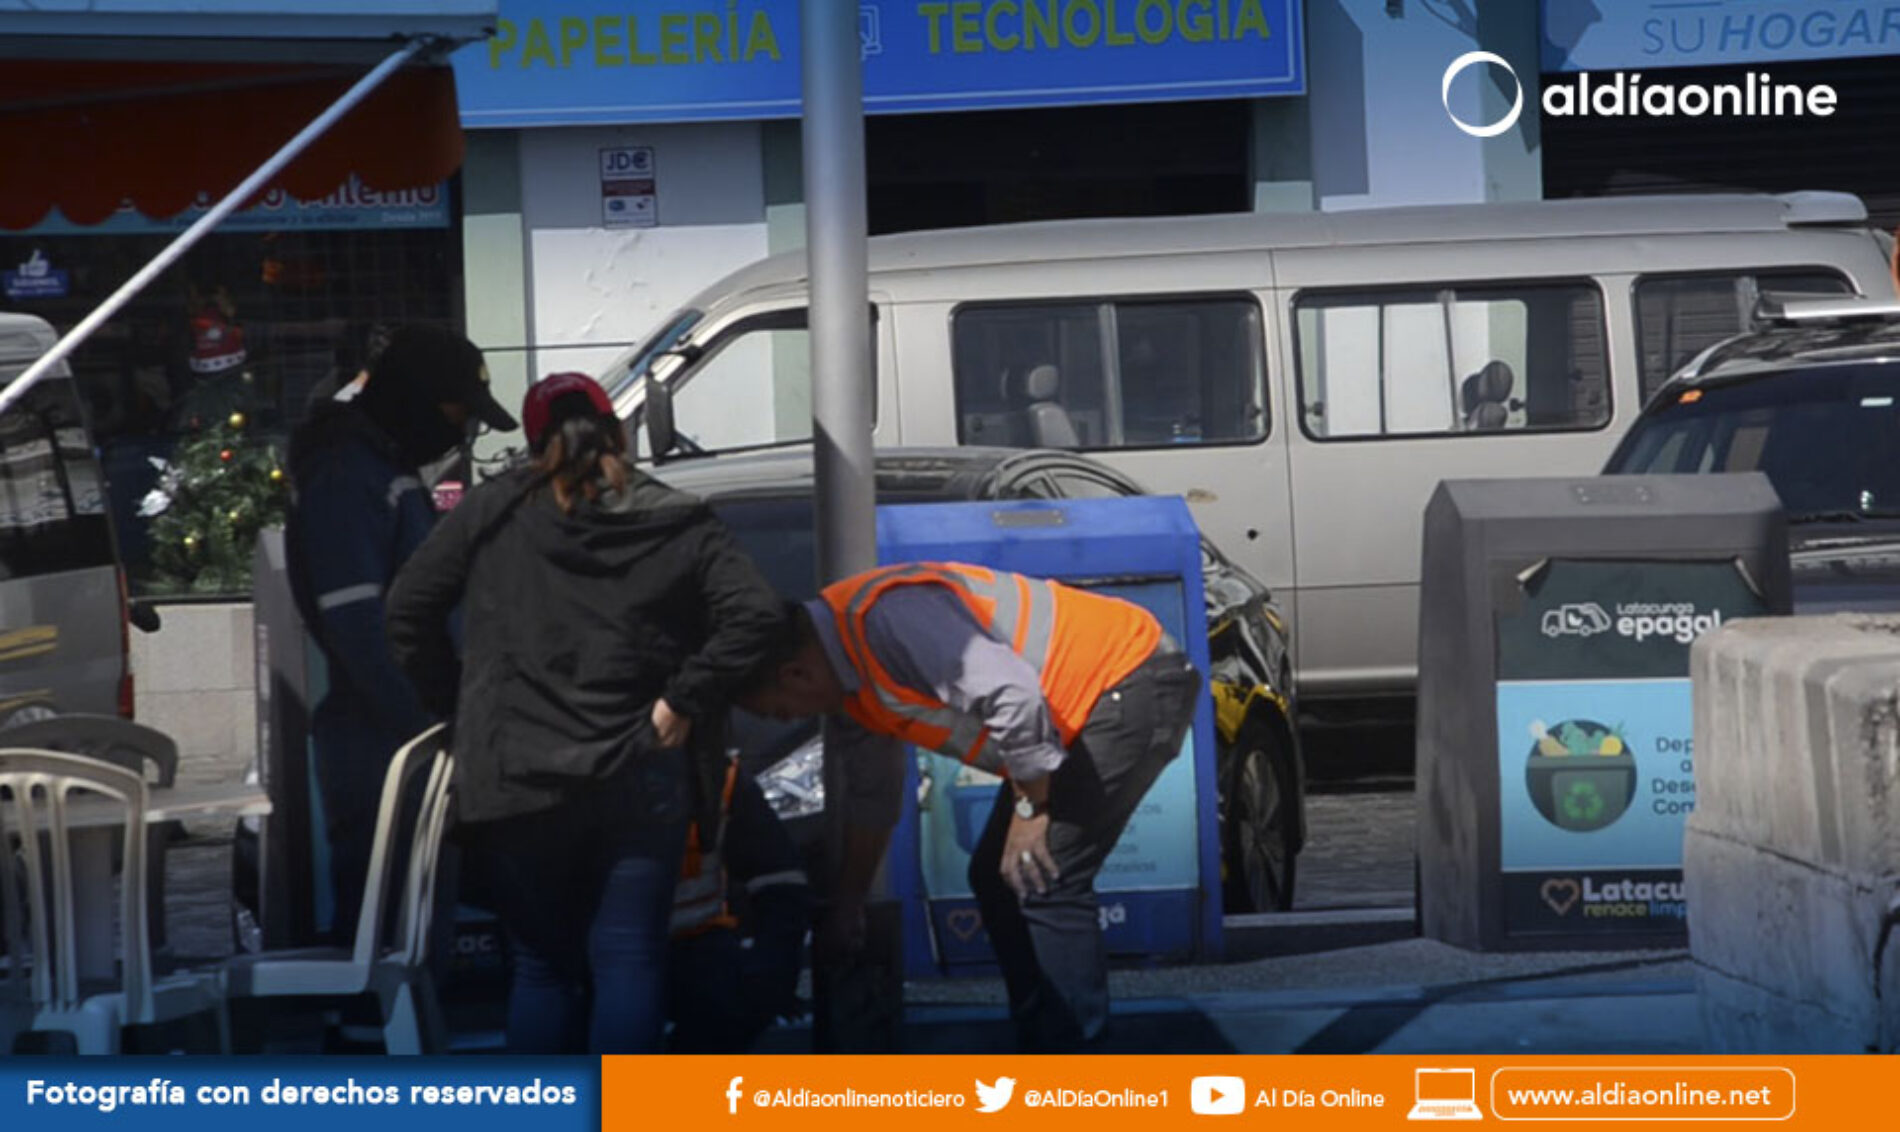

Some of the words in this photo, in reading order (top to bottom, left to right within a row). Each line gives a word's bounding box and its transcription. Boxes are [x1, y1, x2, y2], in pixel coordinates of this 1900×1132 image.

[489, 0, 782, 69] PAPELERÍA
[1643, 17, 1705, 54] SU
[1616, 602, 1694, 615] Latacunga
[1656, 736, 1695, 755] Dep
[1652, 777, 1696, 794] Des
[1583, 877, 1685, 901] Latacu
[1584, 902, 1647, 916] renace
[1651, 899, 1688, 918] limp
